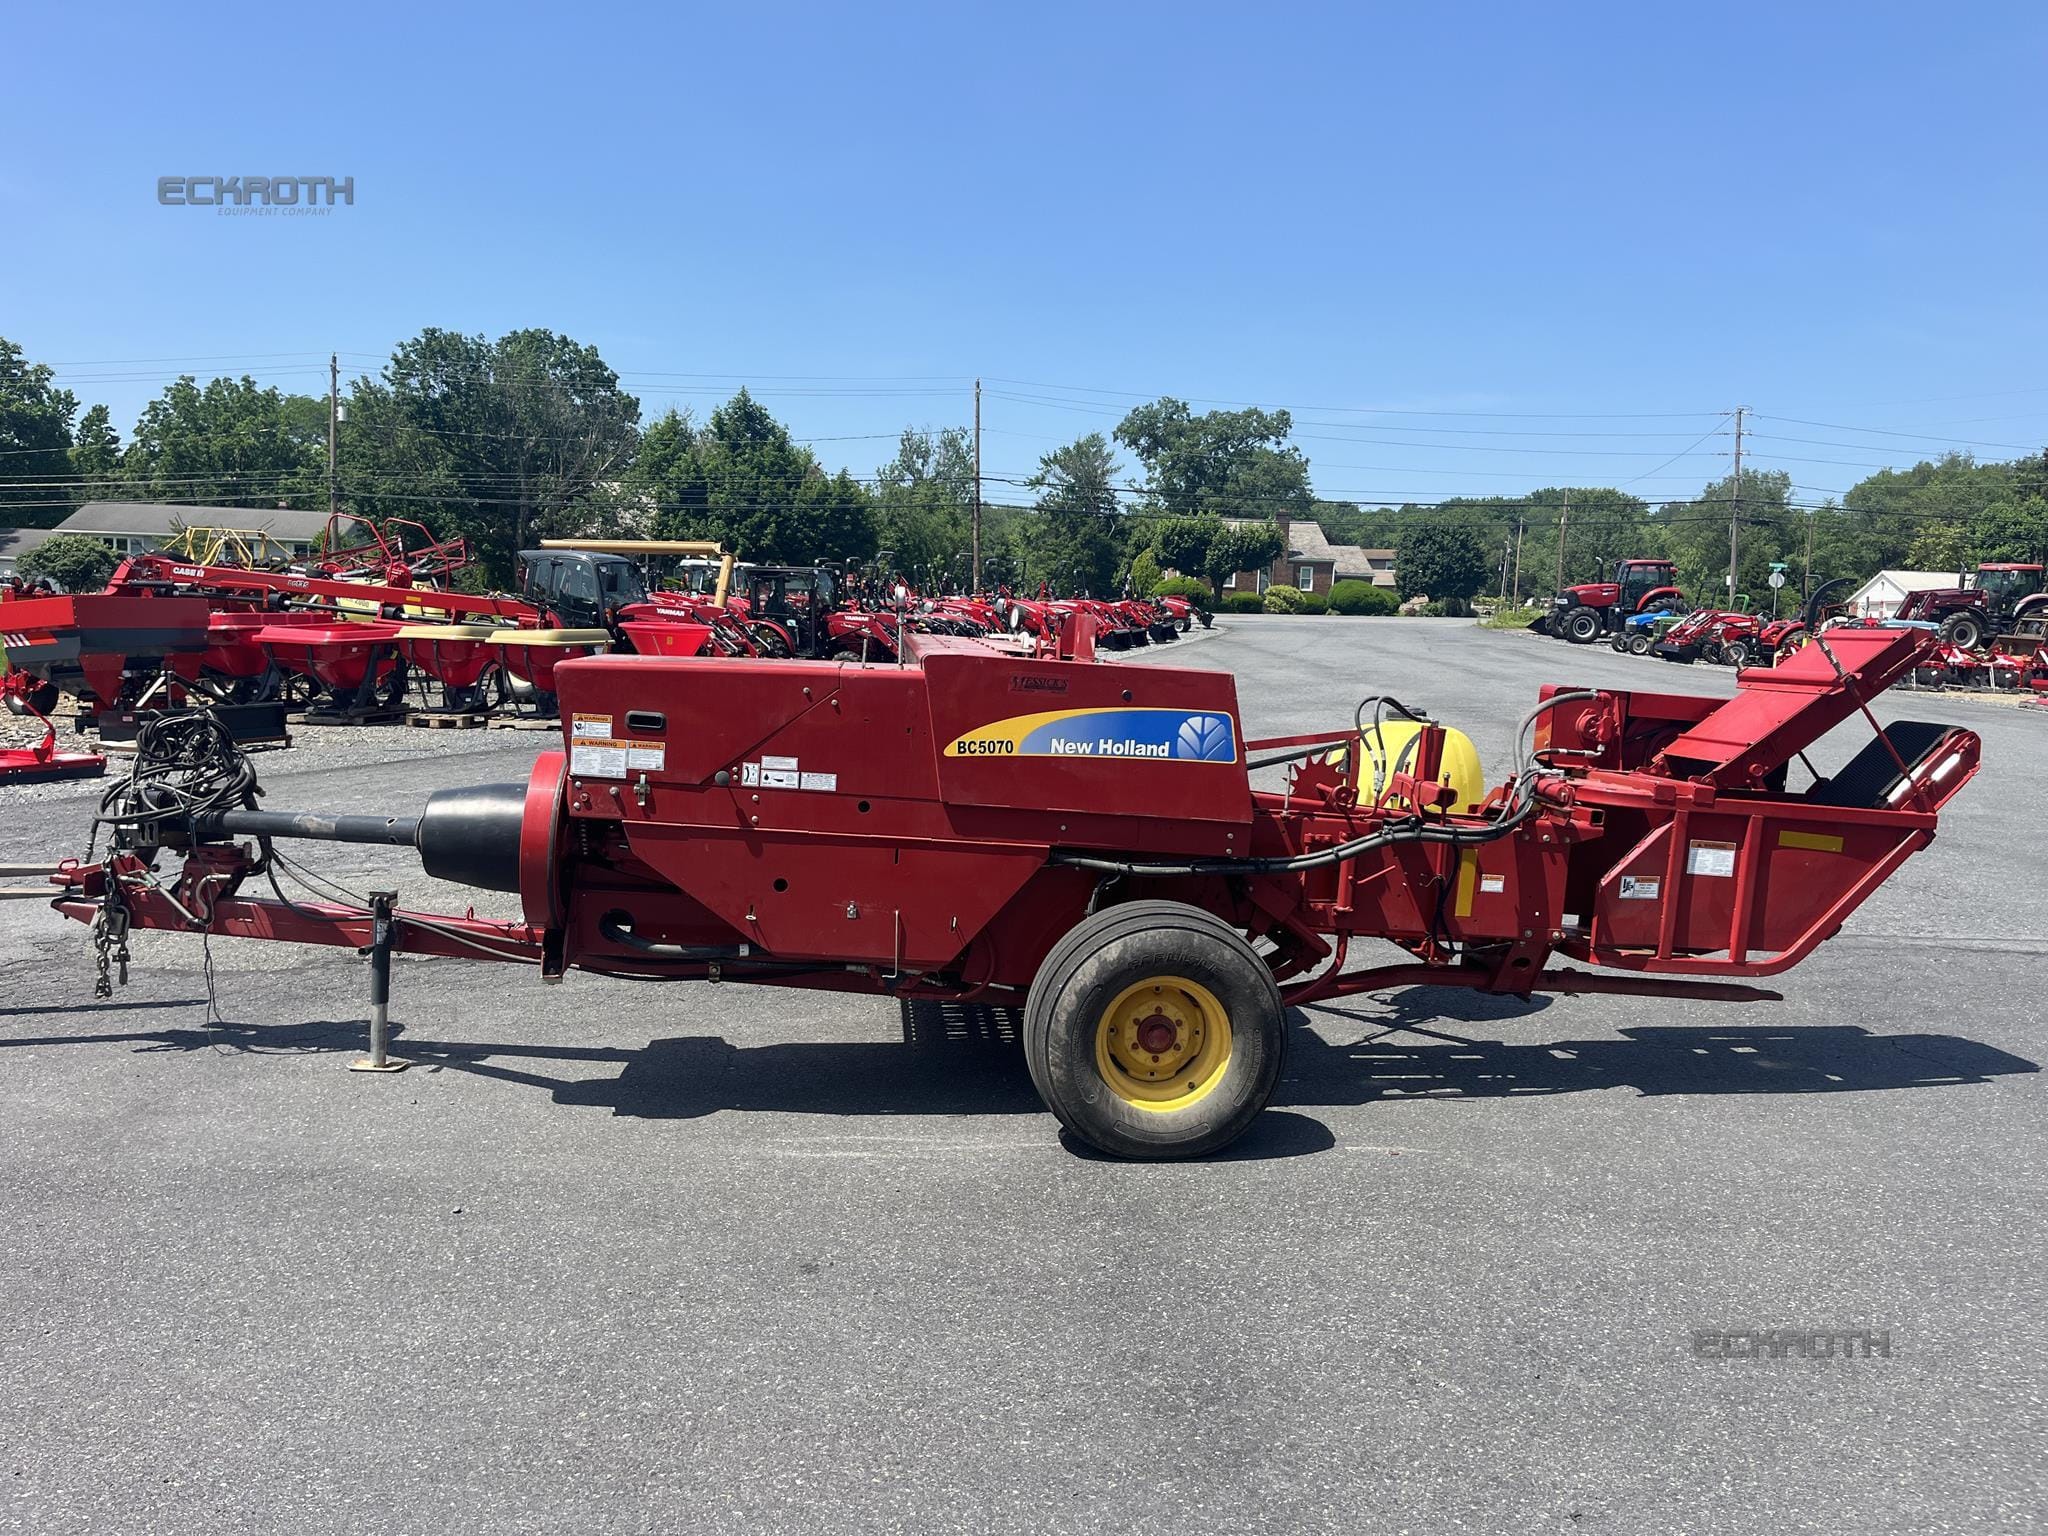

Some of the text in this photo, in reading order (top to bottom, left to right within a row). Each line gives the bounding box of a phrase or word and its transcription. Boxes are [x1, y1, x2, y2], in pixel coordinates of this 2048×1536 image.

[173, 566, 197, 577] CASE
[656, 607, 685, 617] YANMAR
[957, 740, 1014, 755] BC5070
[1050, 738, 1170, 757] New Holland
